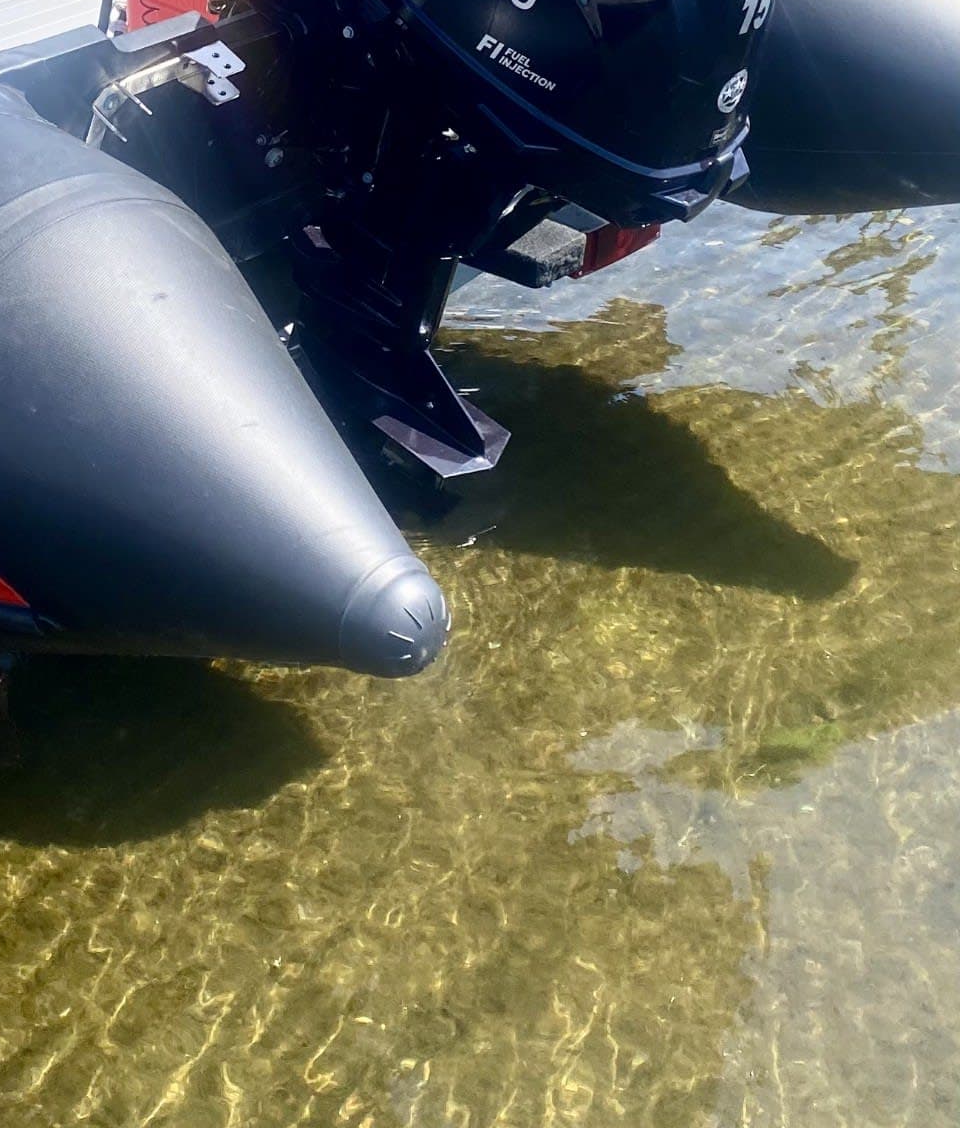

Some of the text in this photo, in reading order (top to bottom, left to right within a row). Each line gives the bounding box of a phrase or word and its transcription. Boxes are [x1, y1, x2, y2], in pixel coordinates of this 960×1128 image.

[476, 34, 505, 59] FI
[504, 47, 531, 68] FUEL
[499, 55, 557, 91] INJECTION
